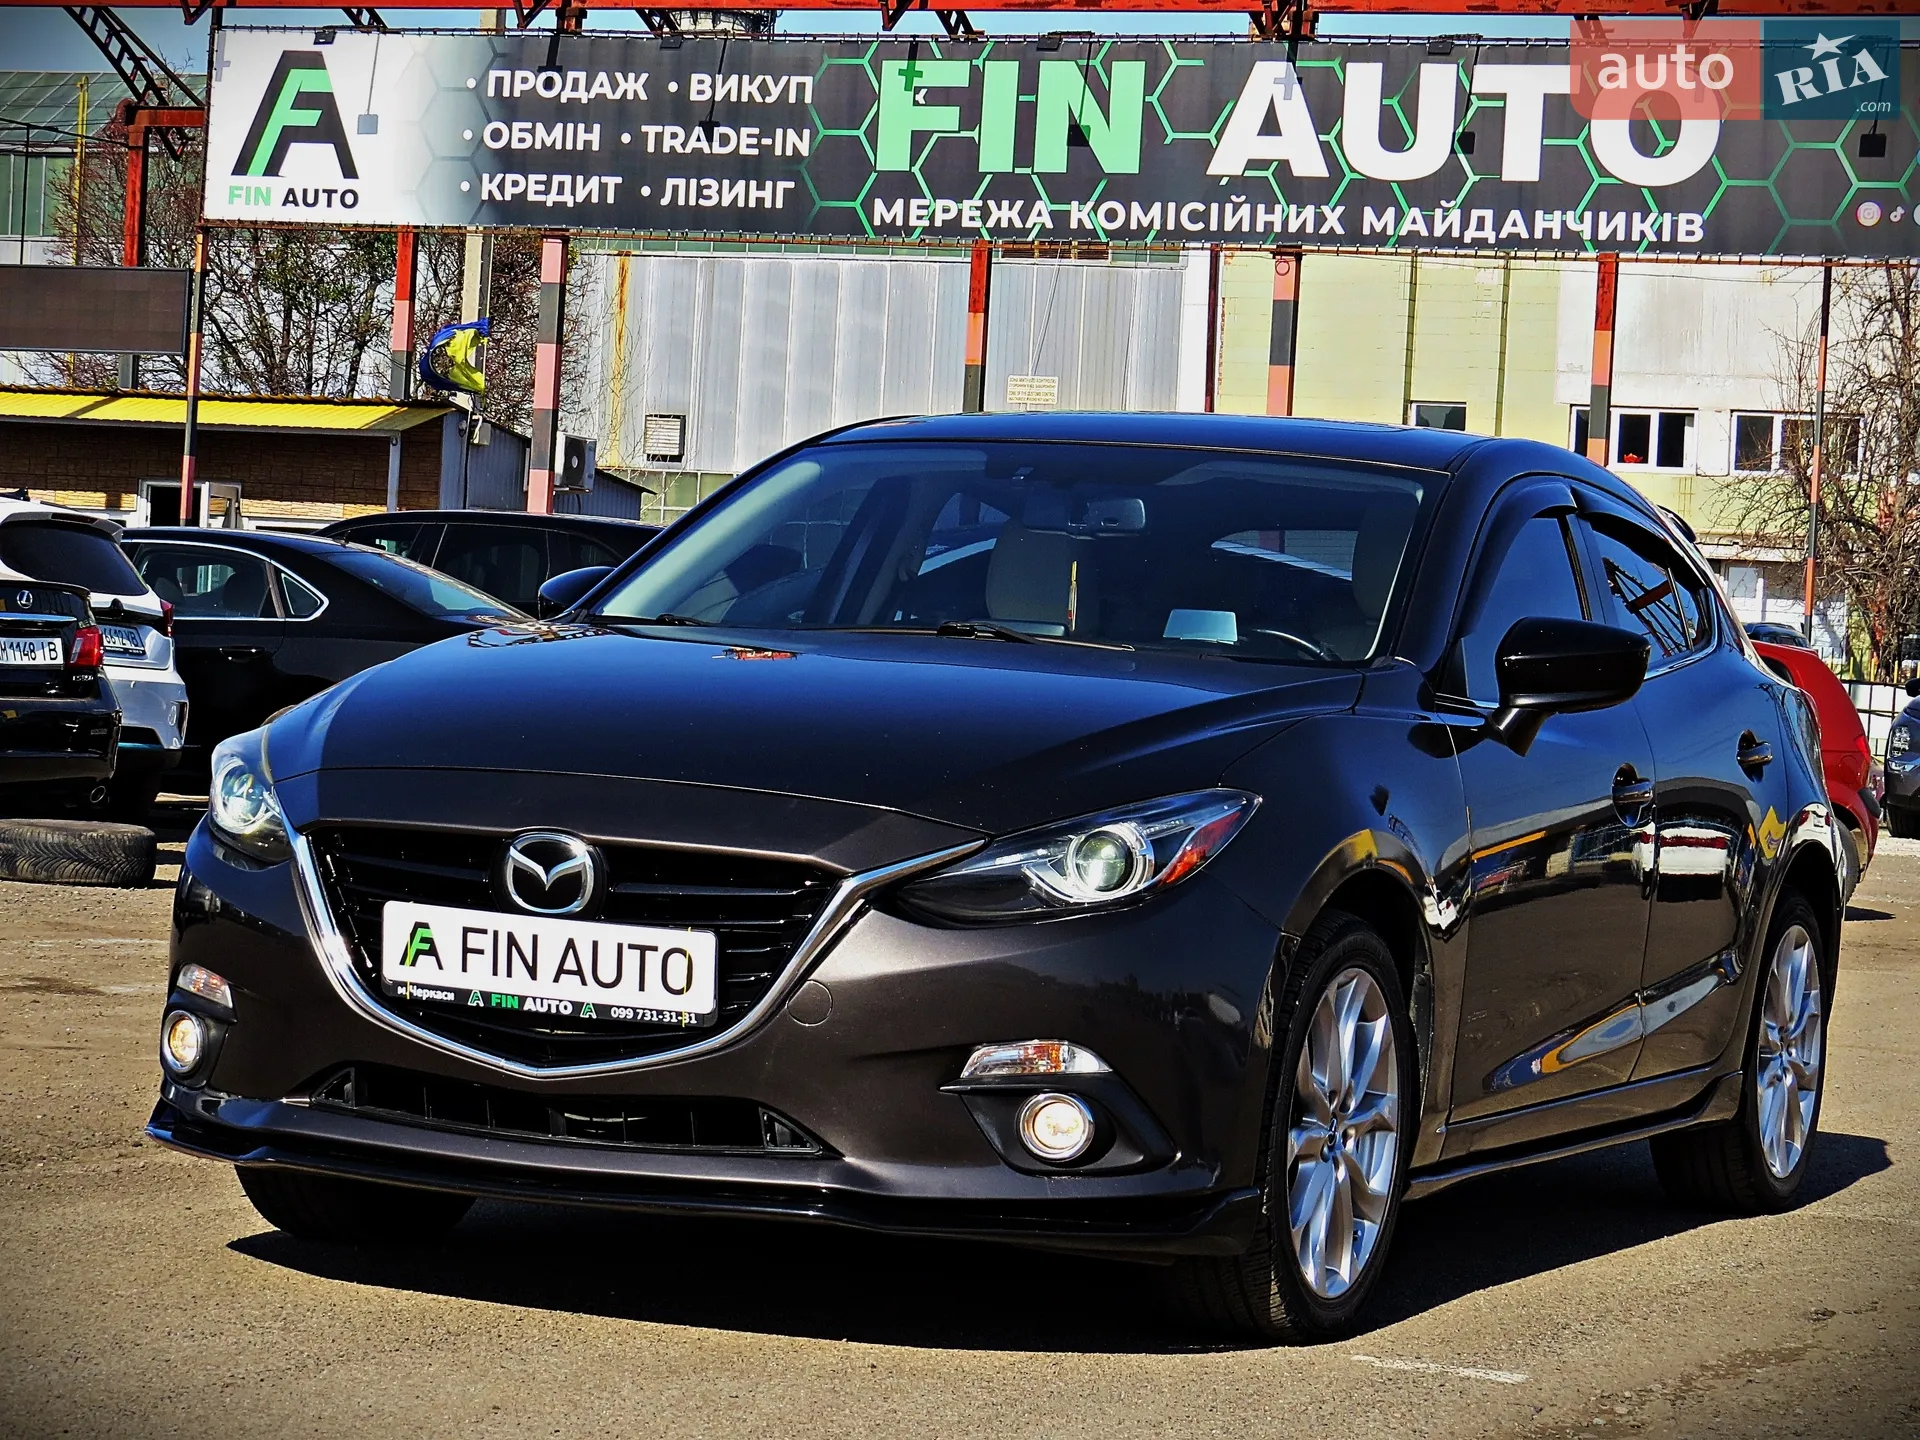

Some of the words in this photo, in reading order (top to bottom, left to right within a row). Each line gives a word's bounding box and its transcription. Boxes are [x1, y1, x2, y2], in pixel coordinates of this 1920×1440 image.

[486, 69, 649, 104] ПРОДАЖ
[688, 73, 813, 104] ВИКУП
[482, 121, 602, 152] ОБМІН
[640, 124, 811, 157] TRADE-IN
[875, 59, 1146, 175] FIN
[1206, 61, 1723, 187] AUTO
[228, 185, 272, 207] FIN
[281, 187, 360, 210] AUTO
[481, 172, 623, 208] КРЕДИТ
[660, 177, 796, 210] ЛІЗИНГ
[873, 197, 1055, 231] МЕРЕЖА
[1069, 194, 1347, 236] КОМІСІЙНИХ
[1362, 200, 1706, 245] МАЙДАНЧИКІВ
[9, 641, 37, 661] 1148
[461, 925, 539, 981] FIN
[552, 937, 694, 996] AUTO
[490, 993, 520, 1010] FIN
[523, 996, 574, 1016] AUTO
[610, 1006, 634, 1020] 099
